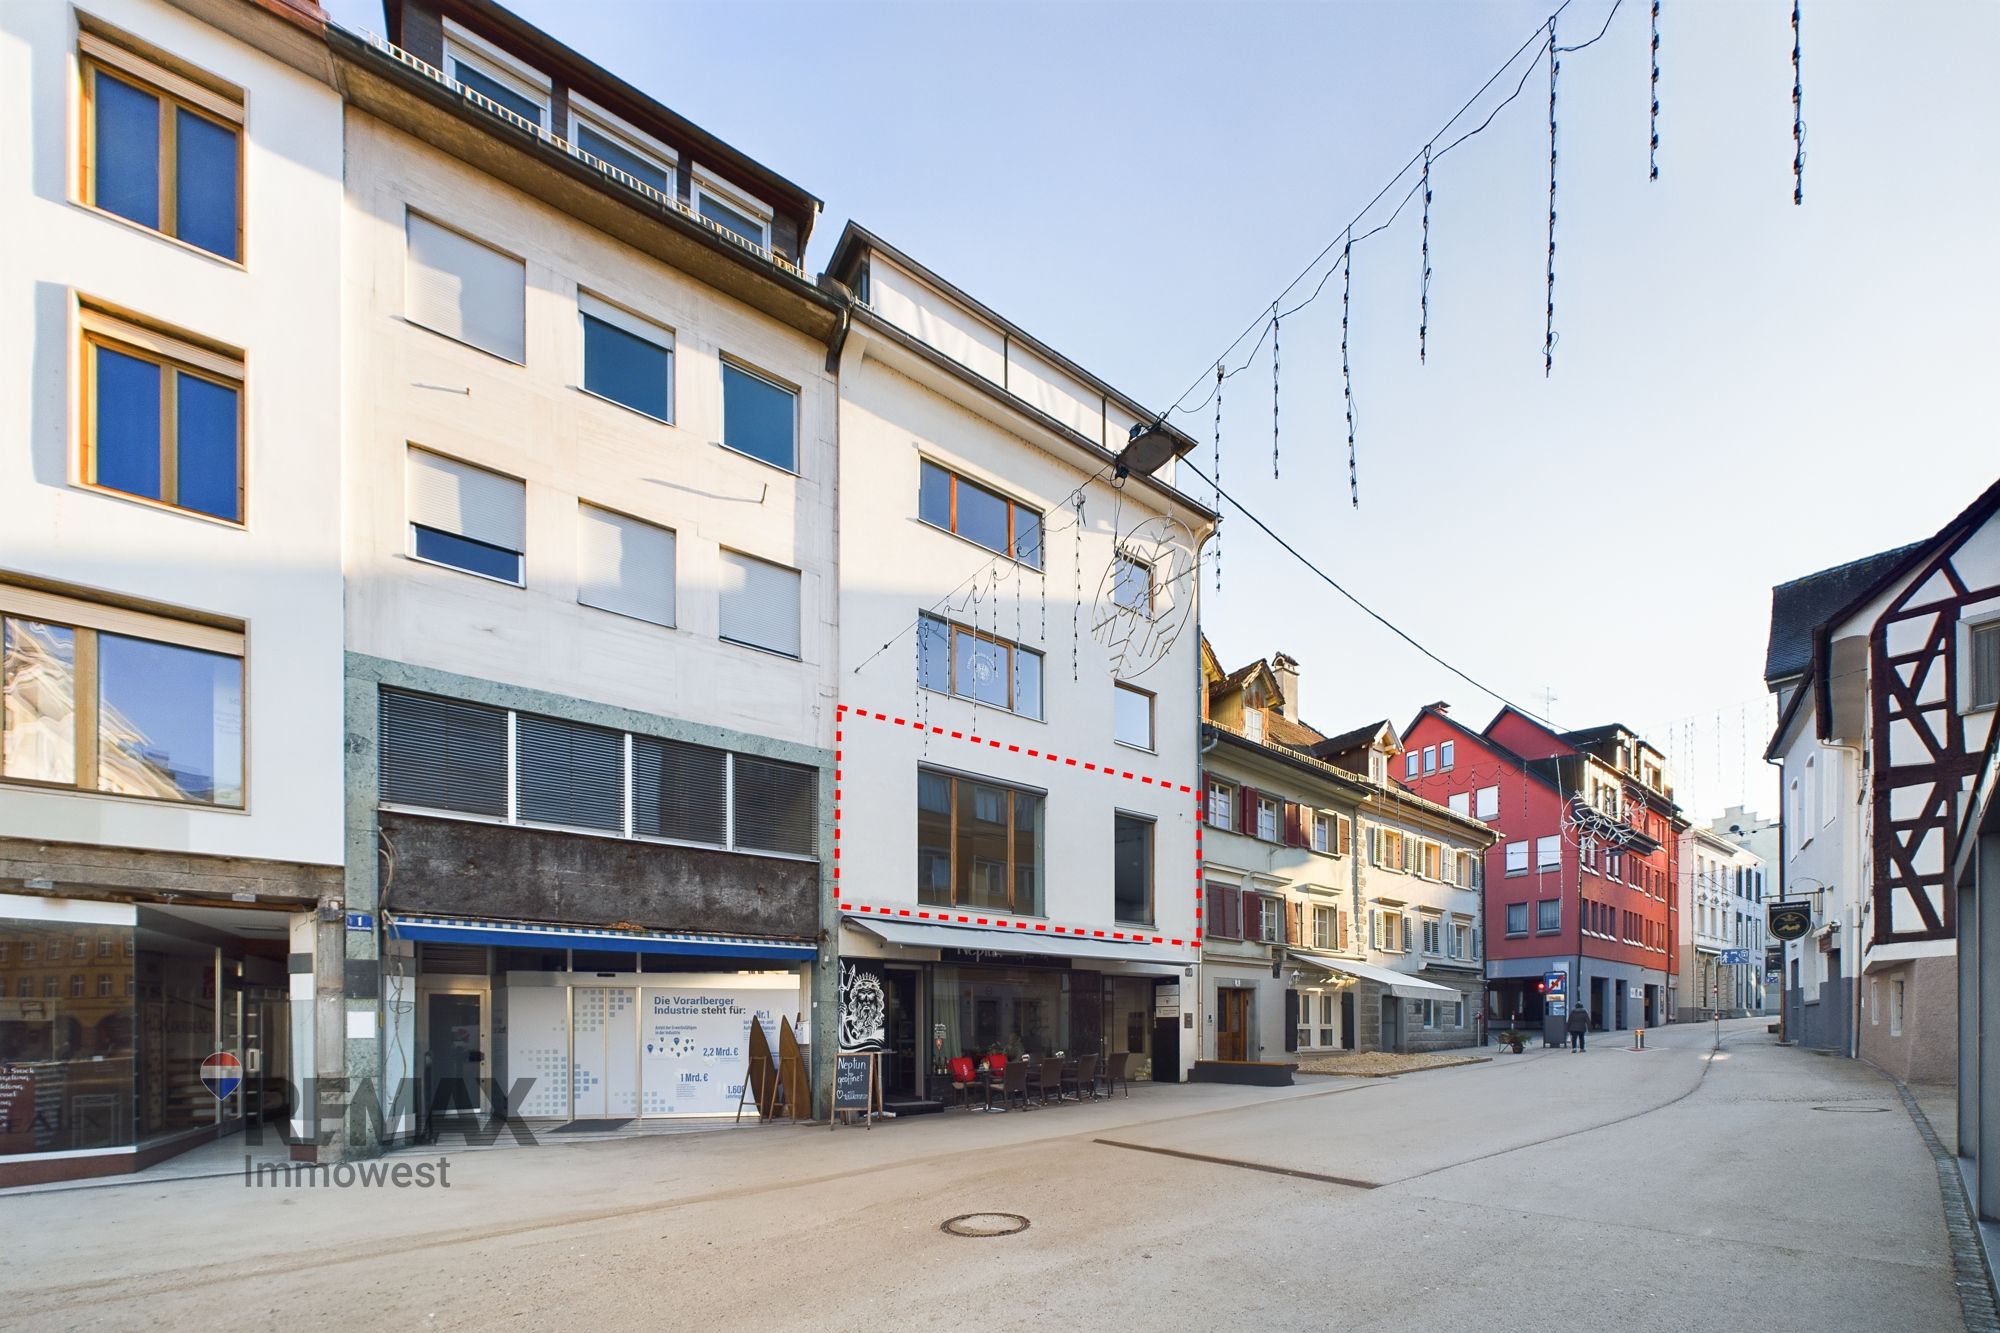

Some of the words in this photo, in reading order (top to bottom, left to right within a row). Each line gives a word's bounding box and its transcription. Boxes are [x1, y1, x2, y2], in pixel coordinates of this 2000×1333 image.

[357, 916, 362, 926] 1
[654, 996, 671, 1005] Die
[673, 996, 735, 1007] Vorarlberger
[654, 1006, 699, 1015] Industrie
[701, 1006, 727, 1015] steht
[729, 1006, 746, 1014] für:
[756, 1010, 766, 1019] Nr.
[703, 1047, 715, 1057] 2,2
[716, 1047, 732, 1056] Mrd.
[733, 1048, 739, 1056] €
[838, 1057, 867, 1075] Neptun
[685, 1073, 702, 1082] Mrd.
[703, 1073, 709, 1081] €
